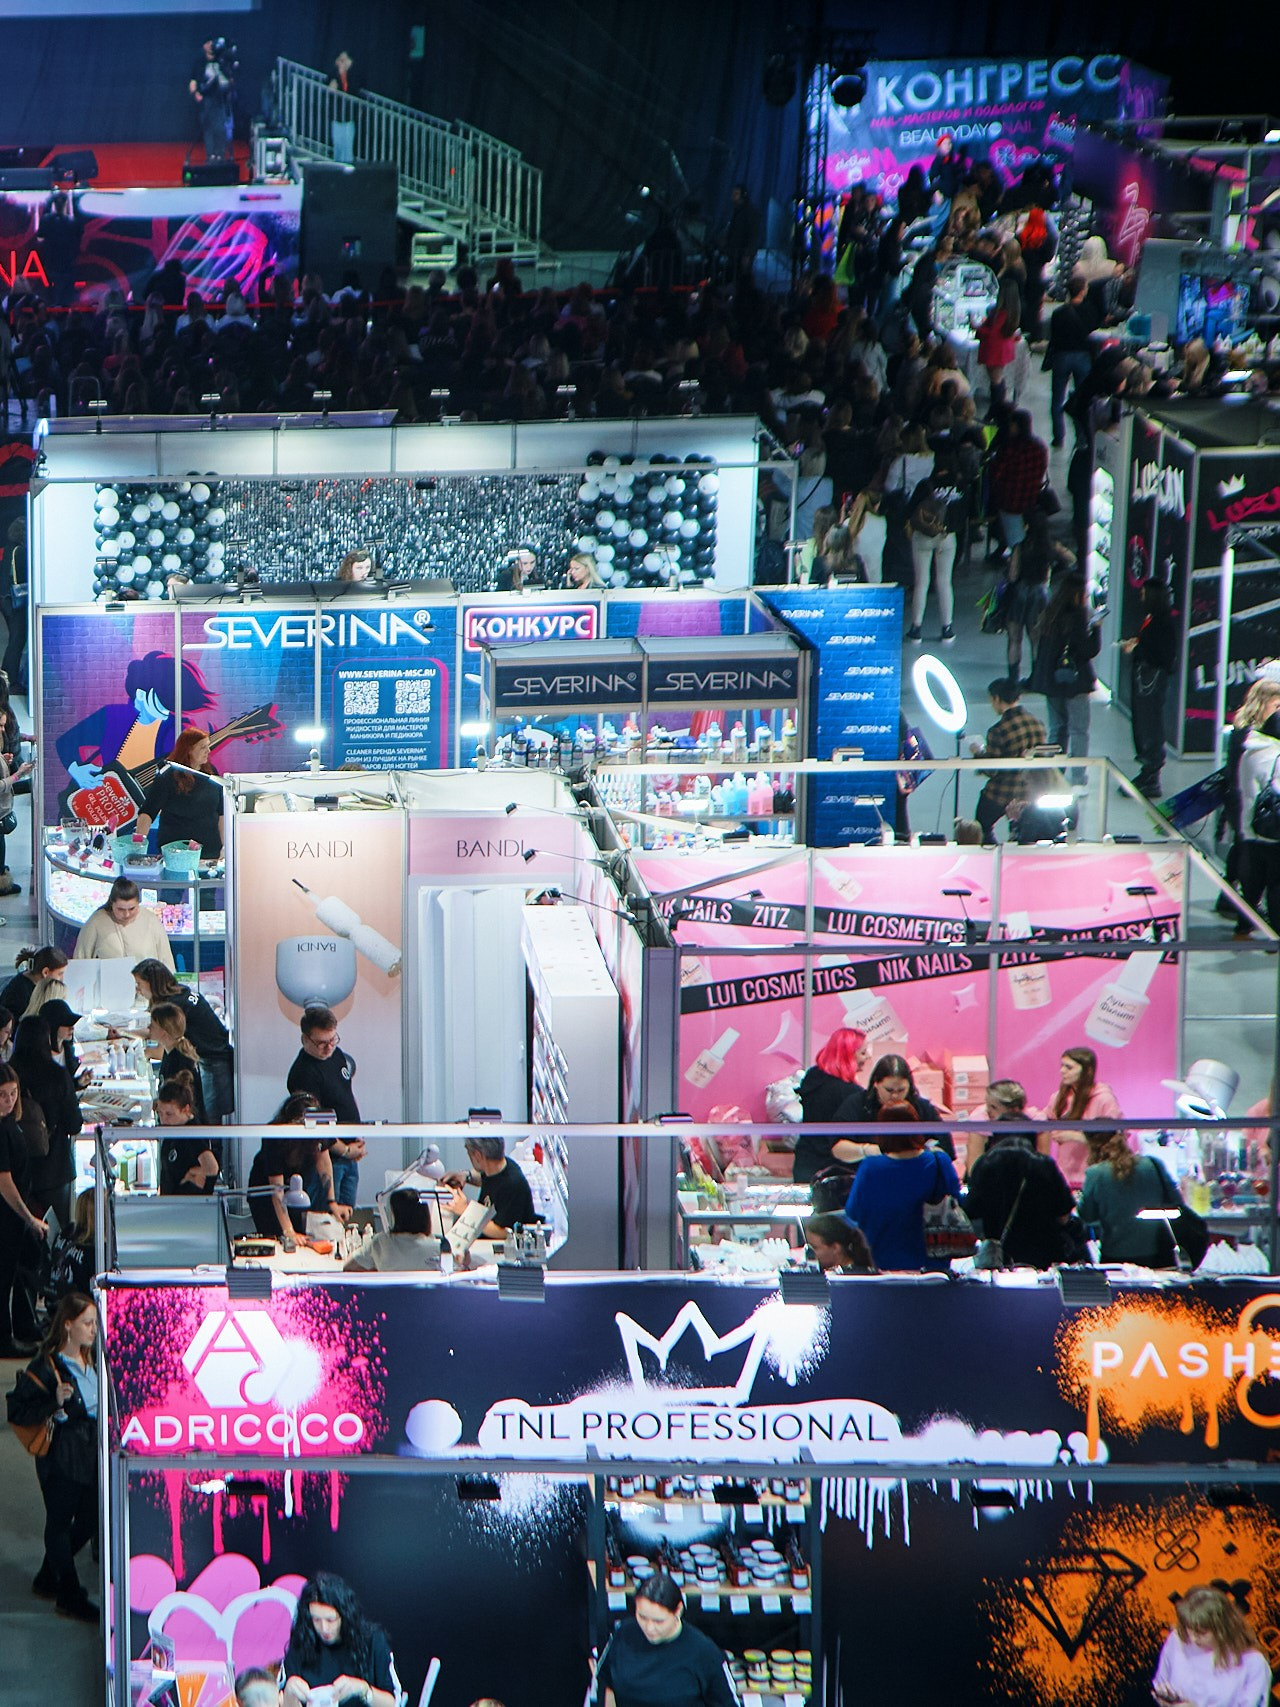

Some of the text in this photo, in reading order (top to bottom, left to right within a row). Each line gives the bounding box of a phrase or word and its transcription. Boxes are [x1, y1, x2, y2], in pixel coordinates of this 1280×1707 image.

[876, 54, 1122, 113] КОНГРЕСС
[471, 614, 592, 639] КОНКУРС
[339, 669, 436, 679] WWW.SEVERINA-MSC.RU
[103, 781, 129, 817] severina
[95, 805, 108, 823] POLIS
[286, 840, 354, 860] BANDI
[456, 839, 526, 859] BANDI
[752, 905, 791, 928] ZITZ
[827, 911, 858, 934] LUI
[861, 914, 967, 942] COSMETICS
[297, 942, 337, 952] BANDI
[706, 983, 739, 1008] LUI
[741, 966, 858, 1002] COSMETICS
[877, 957, 914, 983] NIK
[916, 951, 973, 978] NAILS
[121, 1412, 364, 1447] ADRICOCO
[494, 1412, 890, 1441] TNL PROFESSIONAL
